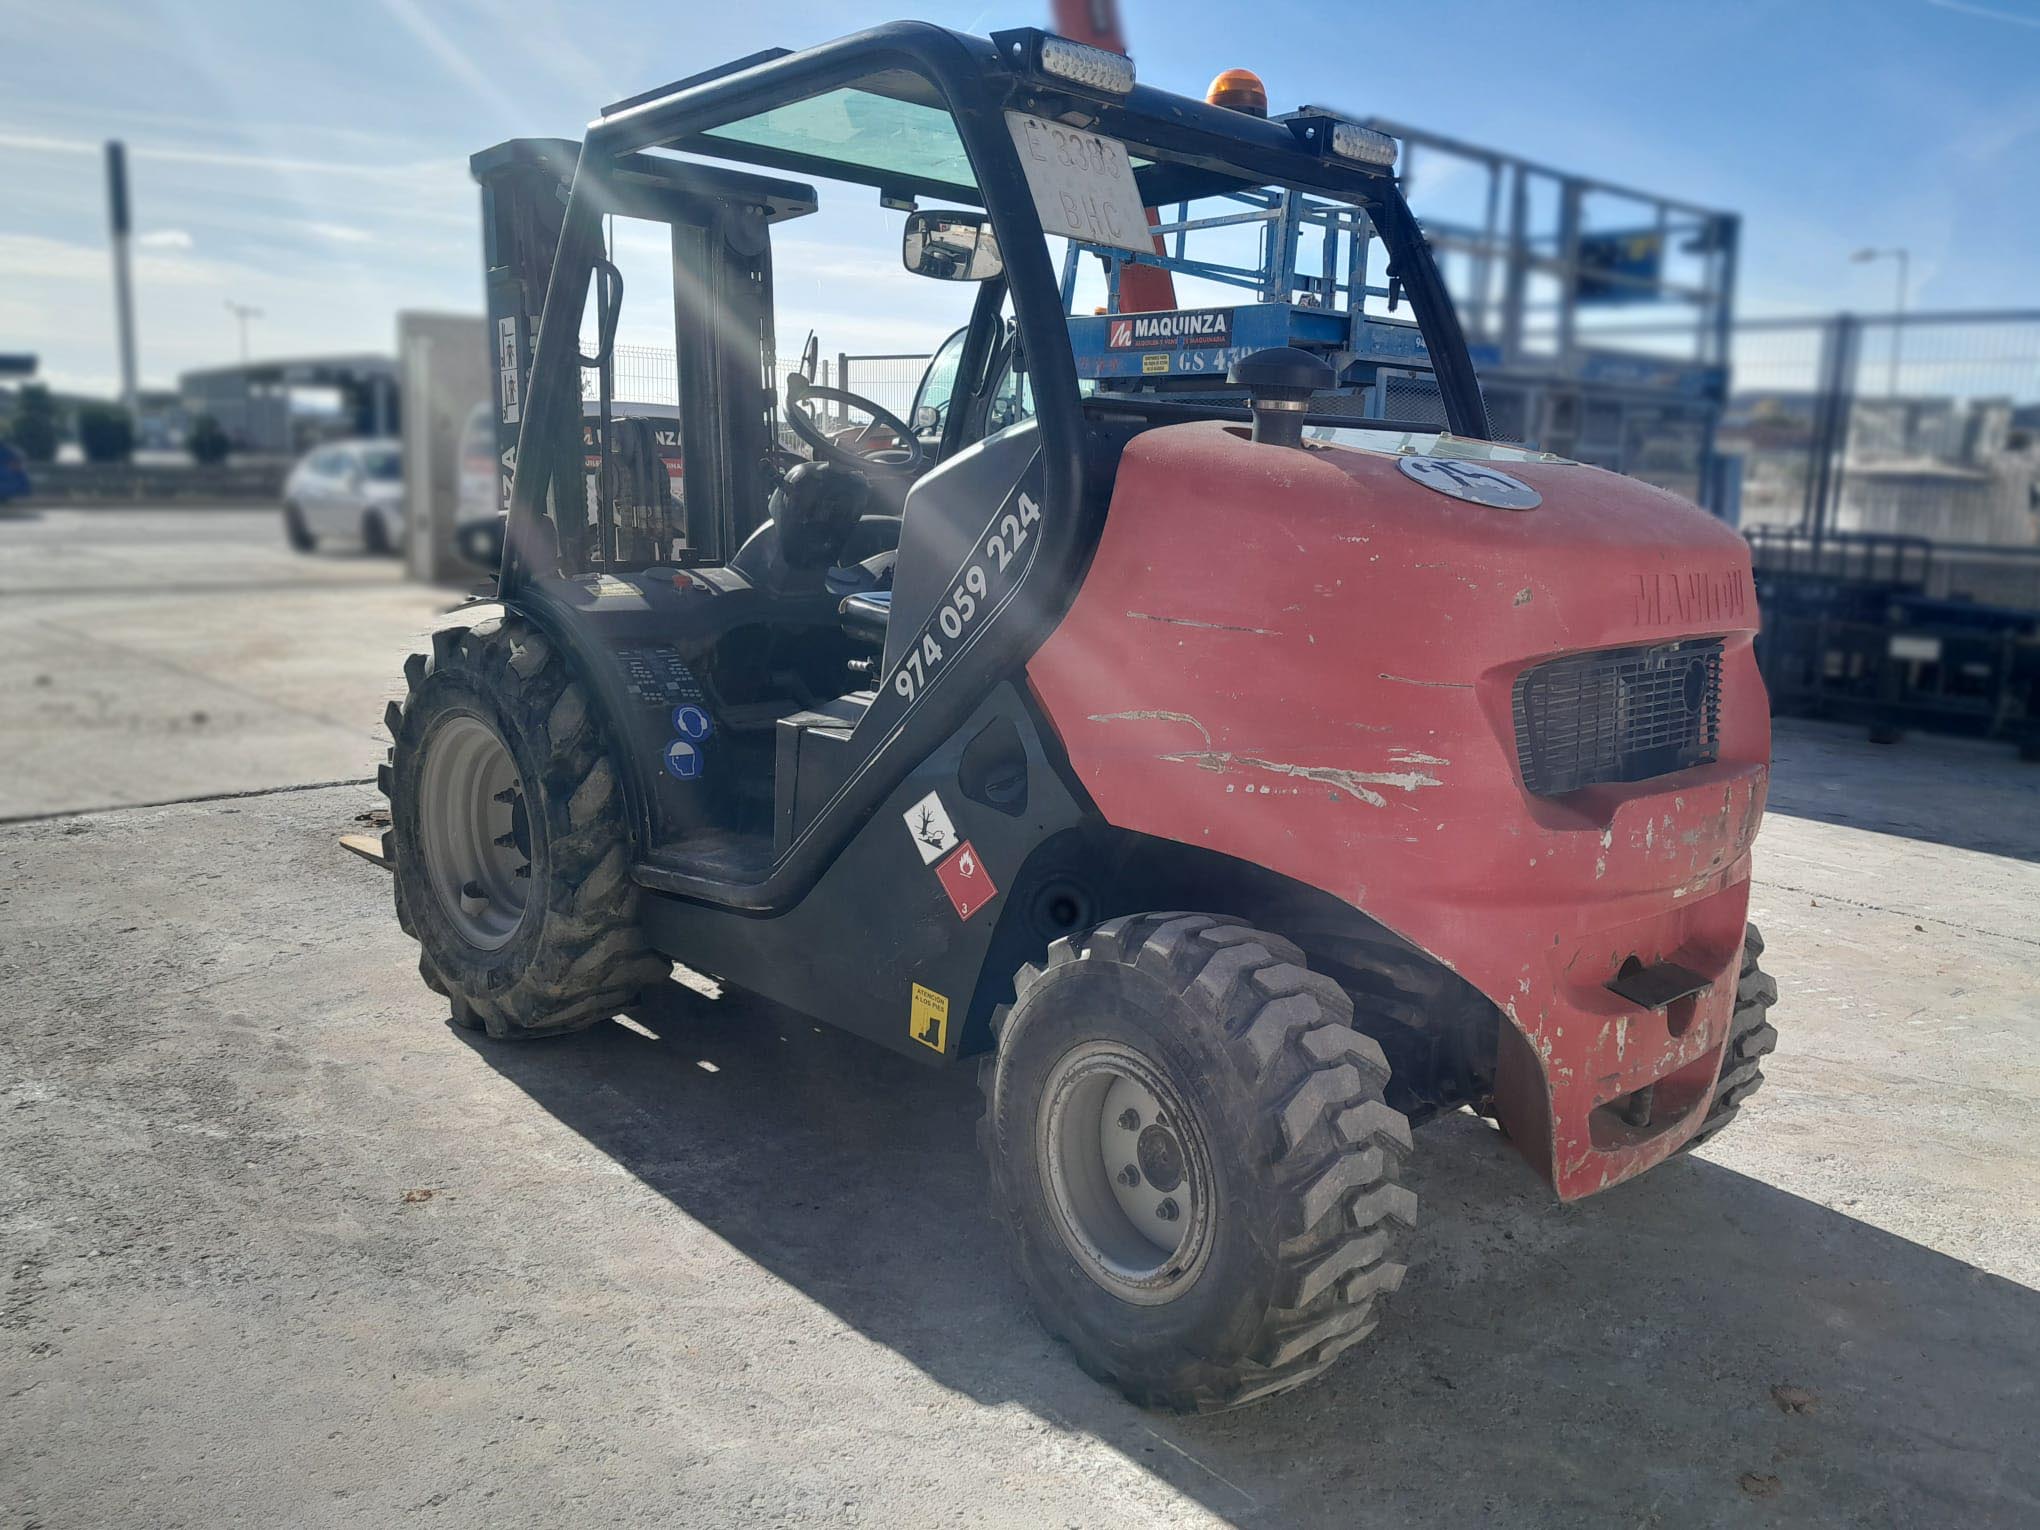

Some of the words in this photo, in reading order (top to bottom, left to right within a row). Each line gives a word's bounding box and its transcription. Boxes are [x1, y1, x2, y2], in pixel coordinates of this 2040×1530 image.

[1059, 190, 1122, 239] BHC
[1135, 313, 1226, 337] MAQUINZA
[1178, 352, 1204, 371] GS
[895, 633, 943, 703] 974
[940, 565, 987, 639] 059
[987, 492, 1041, 573] 224
[961, 902, 968, 914] 3
